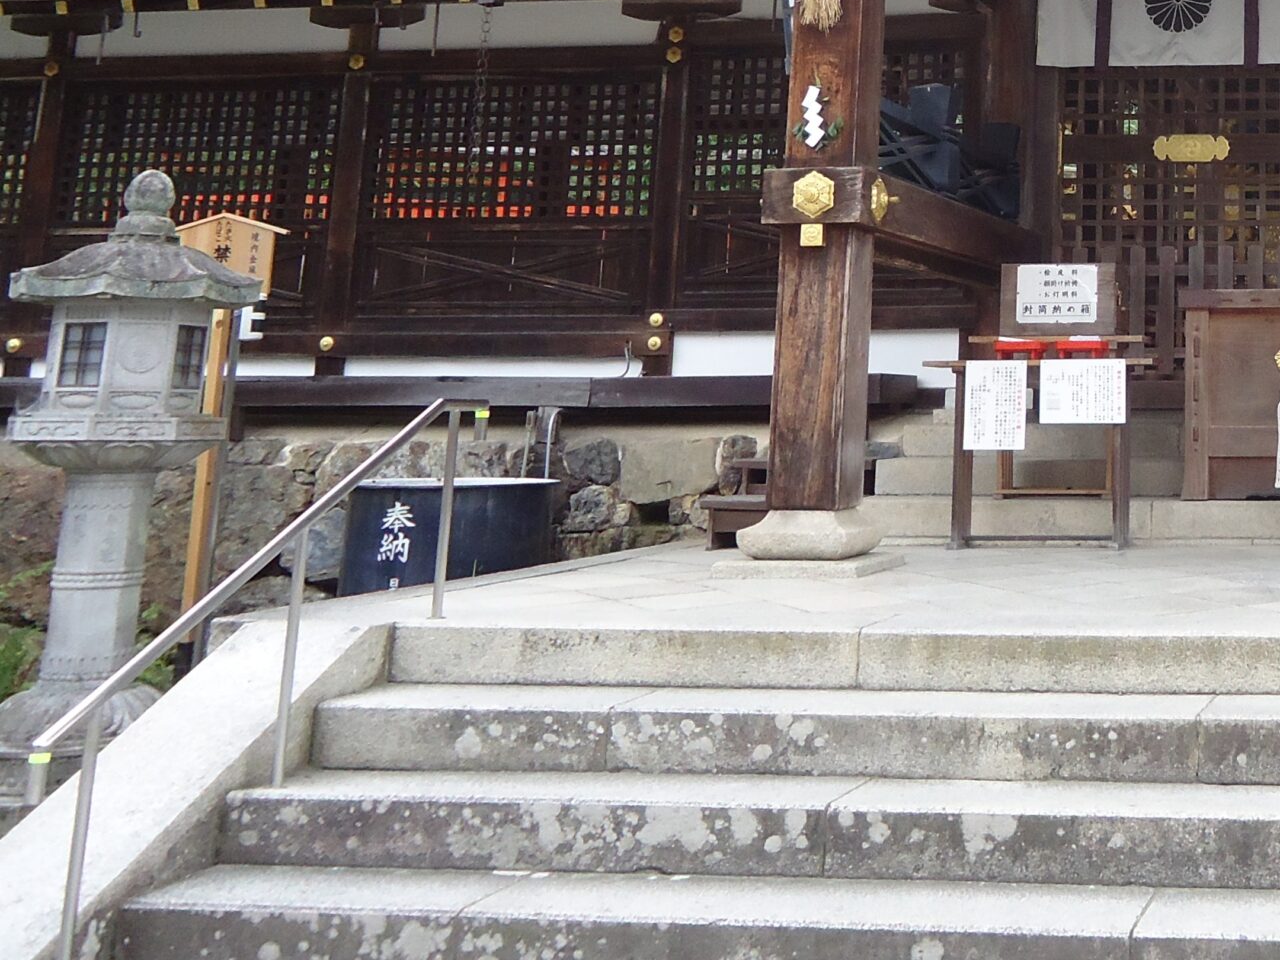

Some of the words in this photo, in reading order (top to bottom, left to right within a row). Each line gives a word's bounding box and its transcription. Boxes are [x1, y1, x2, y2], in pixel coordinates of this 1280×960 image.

[1023, 304, 1090, 315] 封筒納め箱
[377, 501, 416, 563] 奉納
